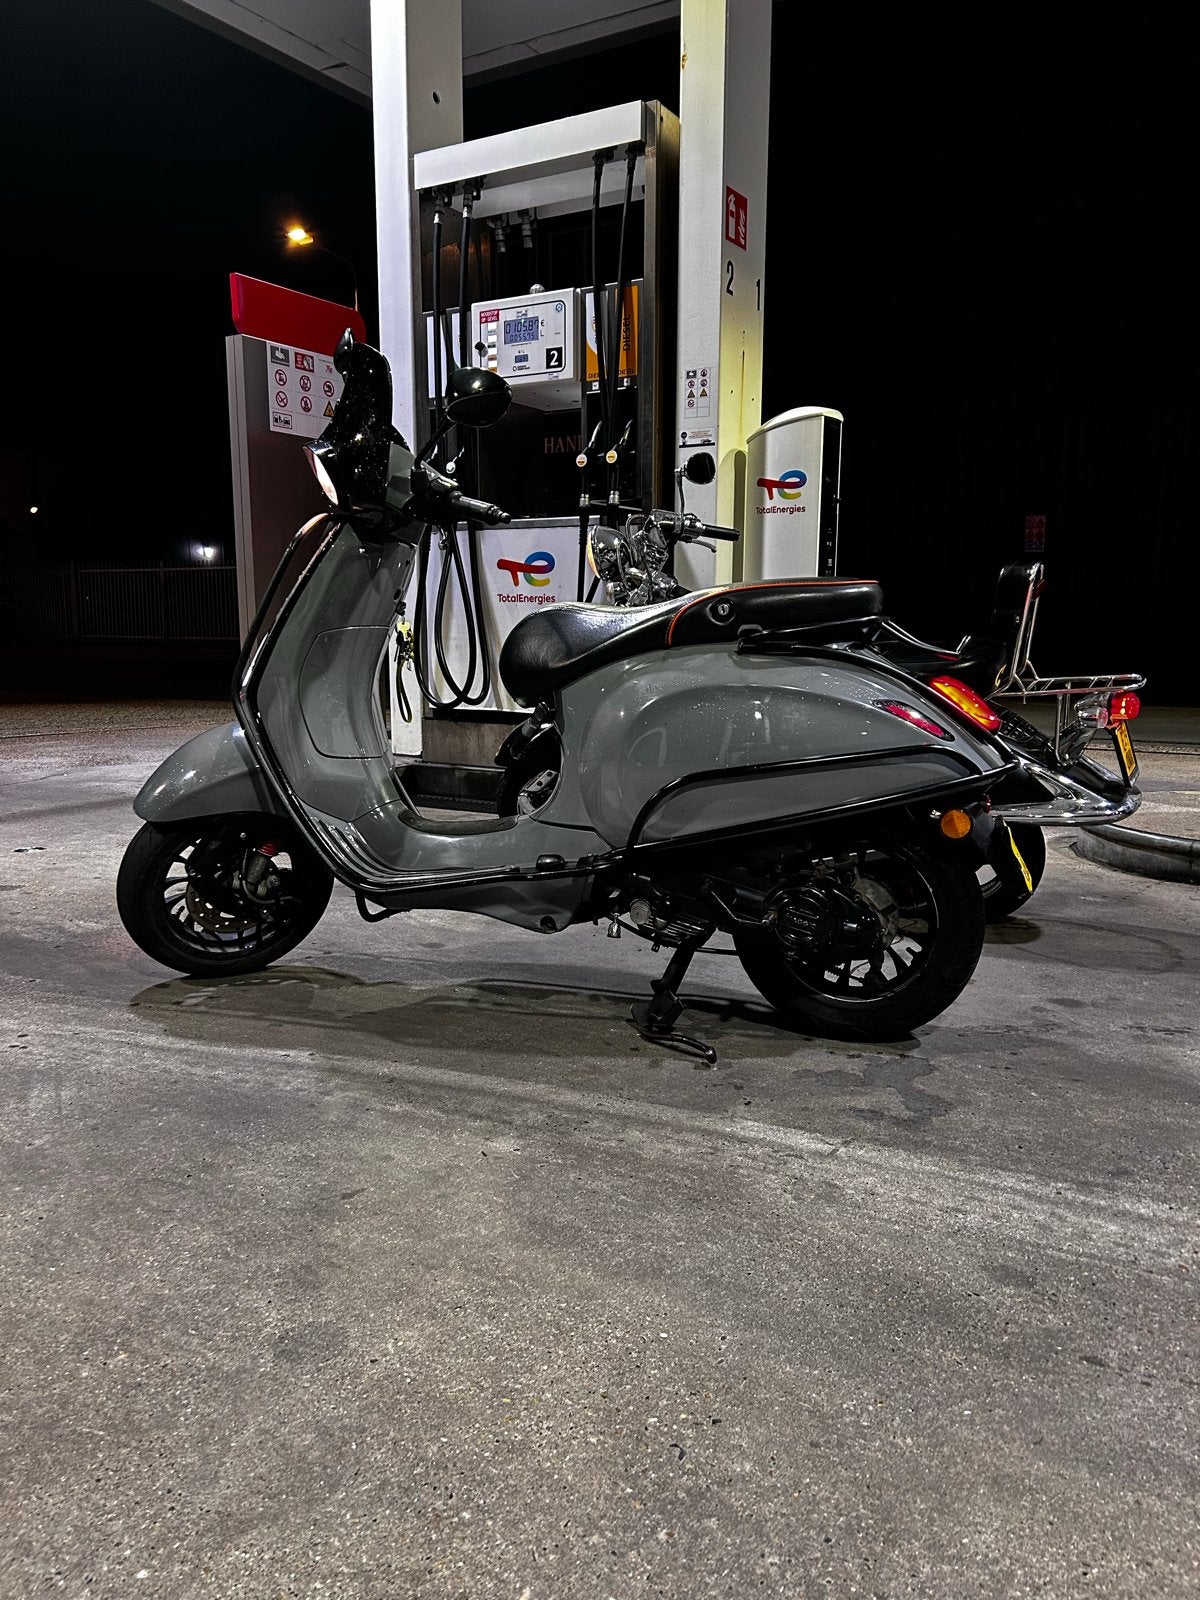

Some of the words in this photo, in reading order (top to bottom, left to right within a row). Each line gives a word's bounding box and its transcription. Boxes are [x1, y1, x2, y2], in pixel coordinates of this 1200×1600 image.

[725, 259, 734, 296] 2
[756, 278, 761, 311] 1
[622, 314, 631, 352] DIESEL
[549, 350, 559, 366] 2
[755, 505, 806, 515] TotalEnergies
[497, 593, 556, 605] TotalEnergies
